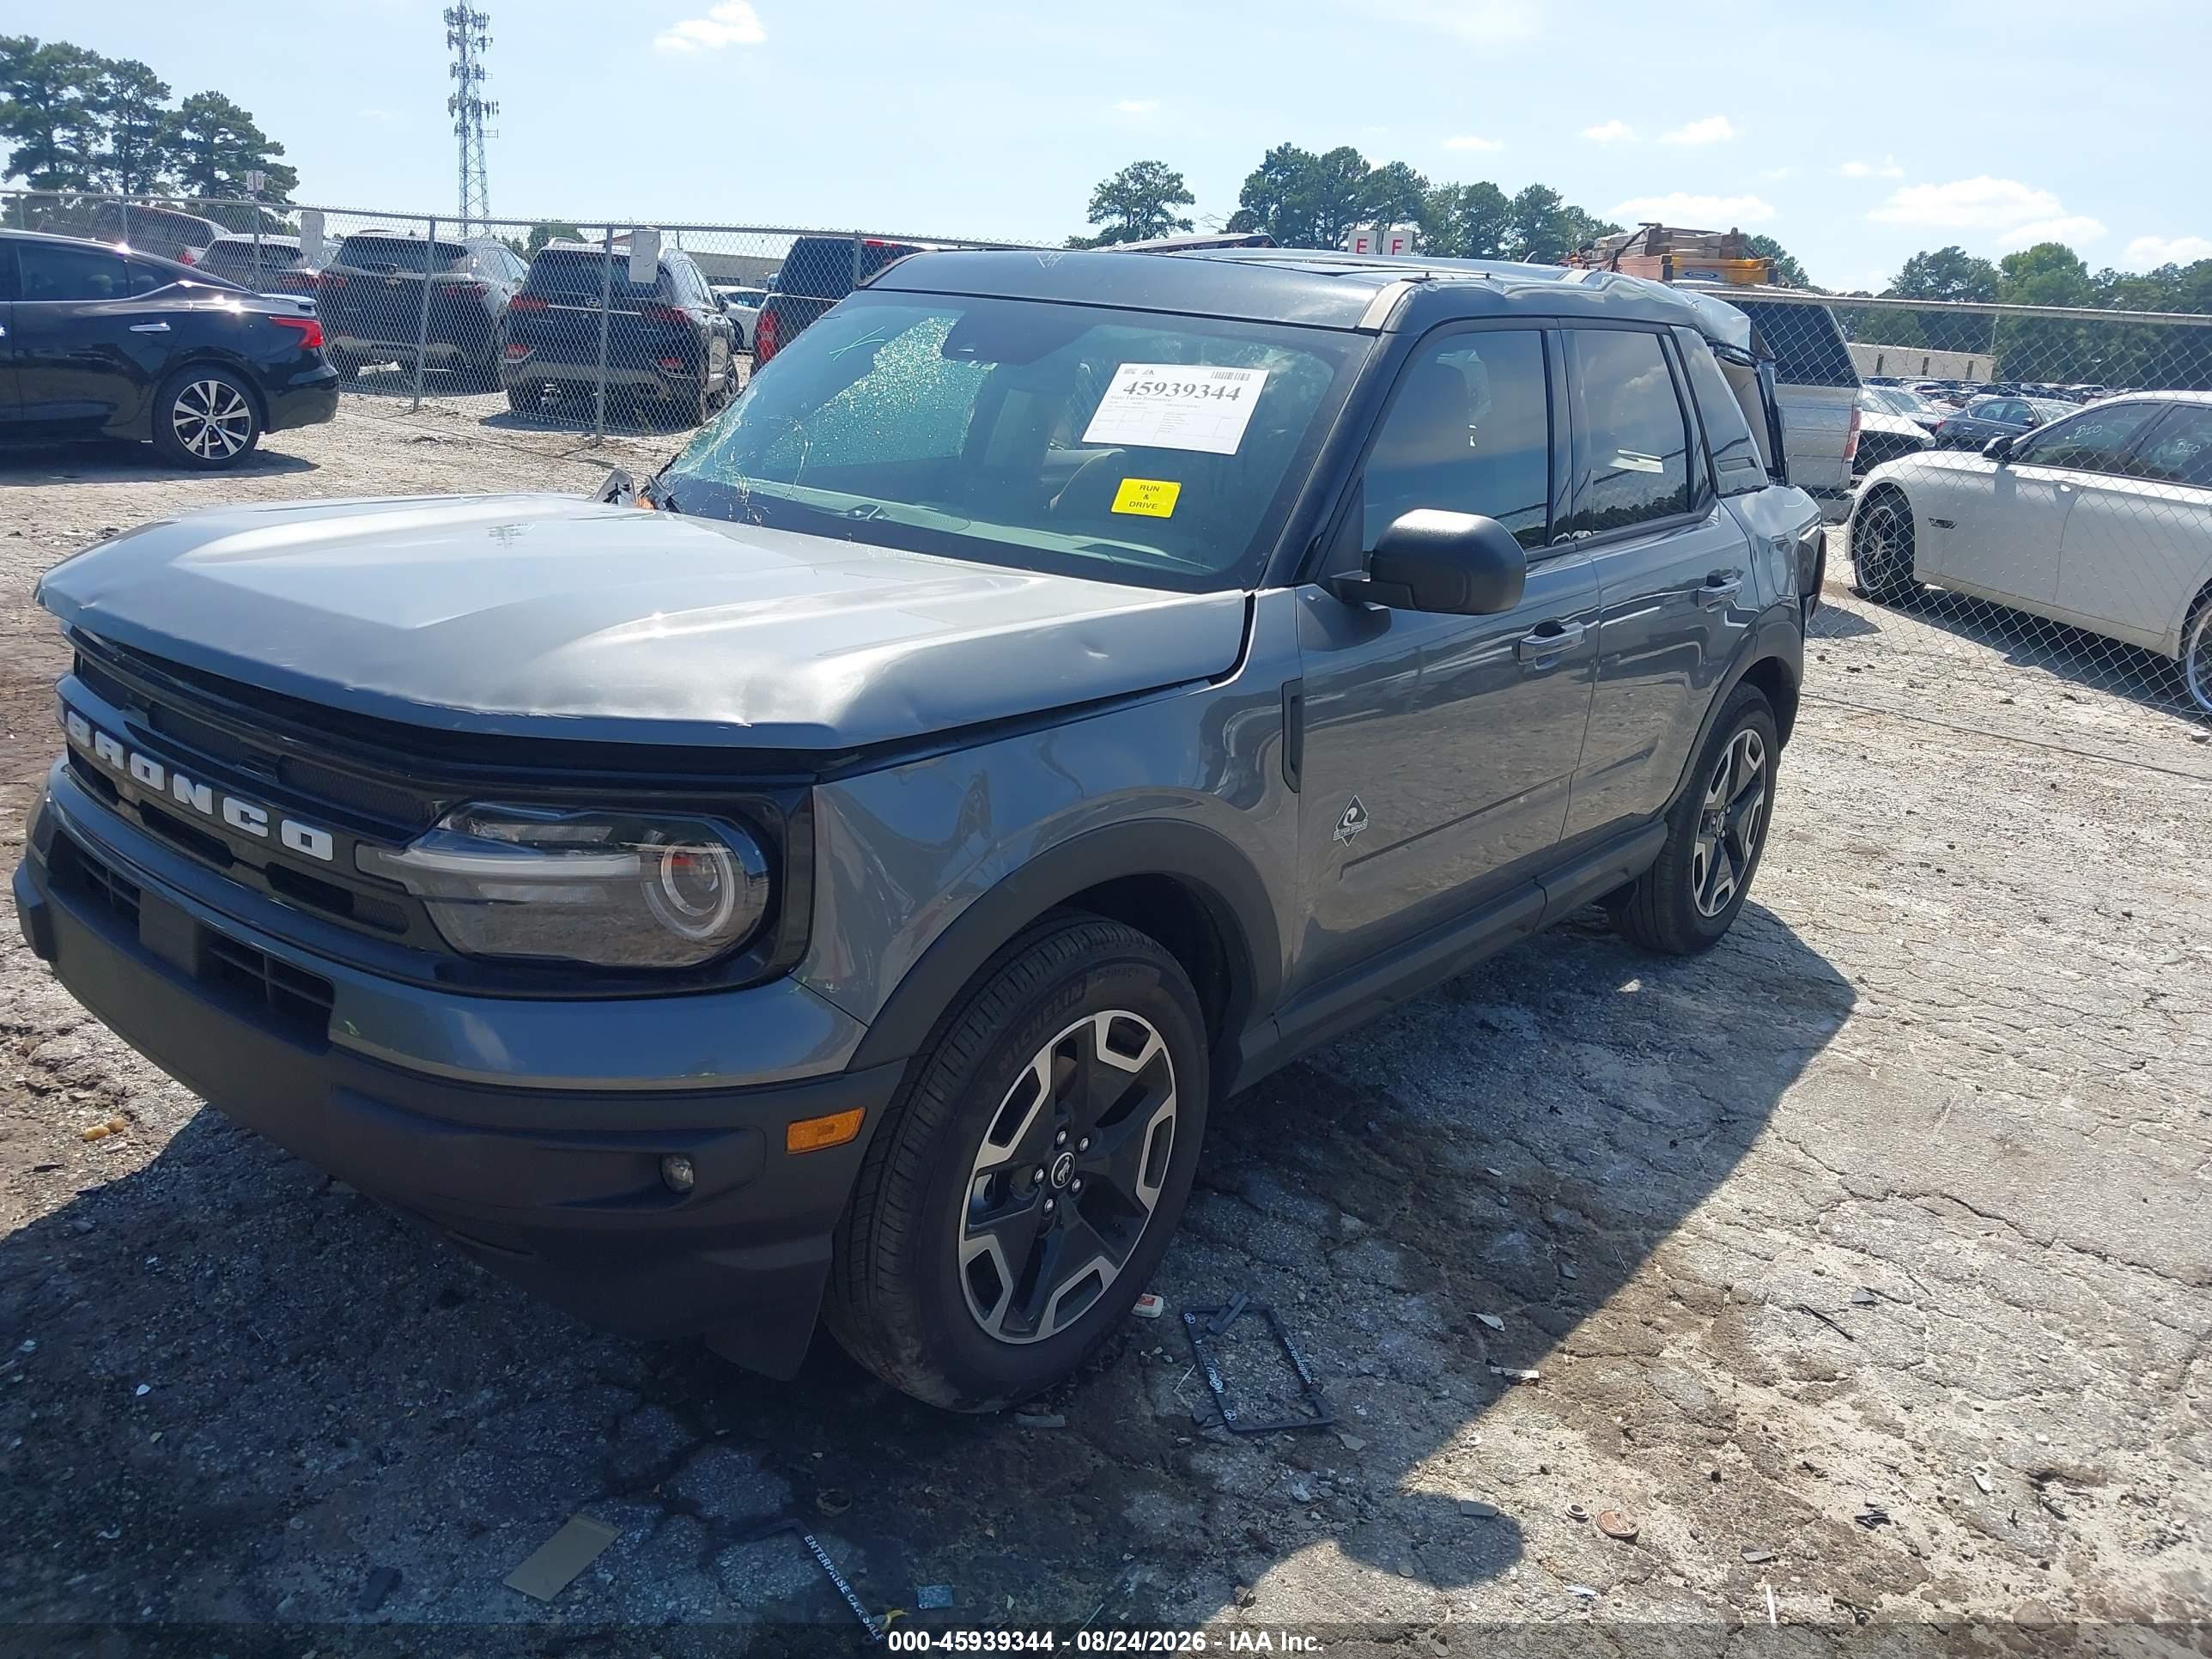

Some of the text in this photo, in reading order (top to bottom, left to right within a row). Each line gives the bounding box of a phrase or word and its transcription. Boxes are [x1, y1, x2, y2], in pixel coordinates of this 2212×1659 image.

[1356, 238, 1368, 254] E
[1391, 239, 1404, 255] F
[1122, 380, 1242, 401] 45939344
[1128, 501, 1158, 509] DRIVE
[68, 710, 333, 861] BRONCO
[804, 1534, 851, 1594] ENTERPRISE
